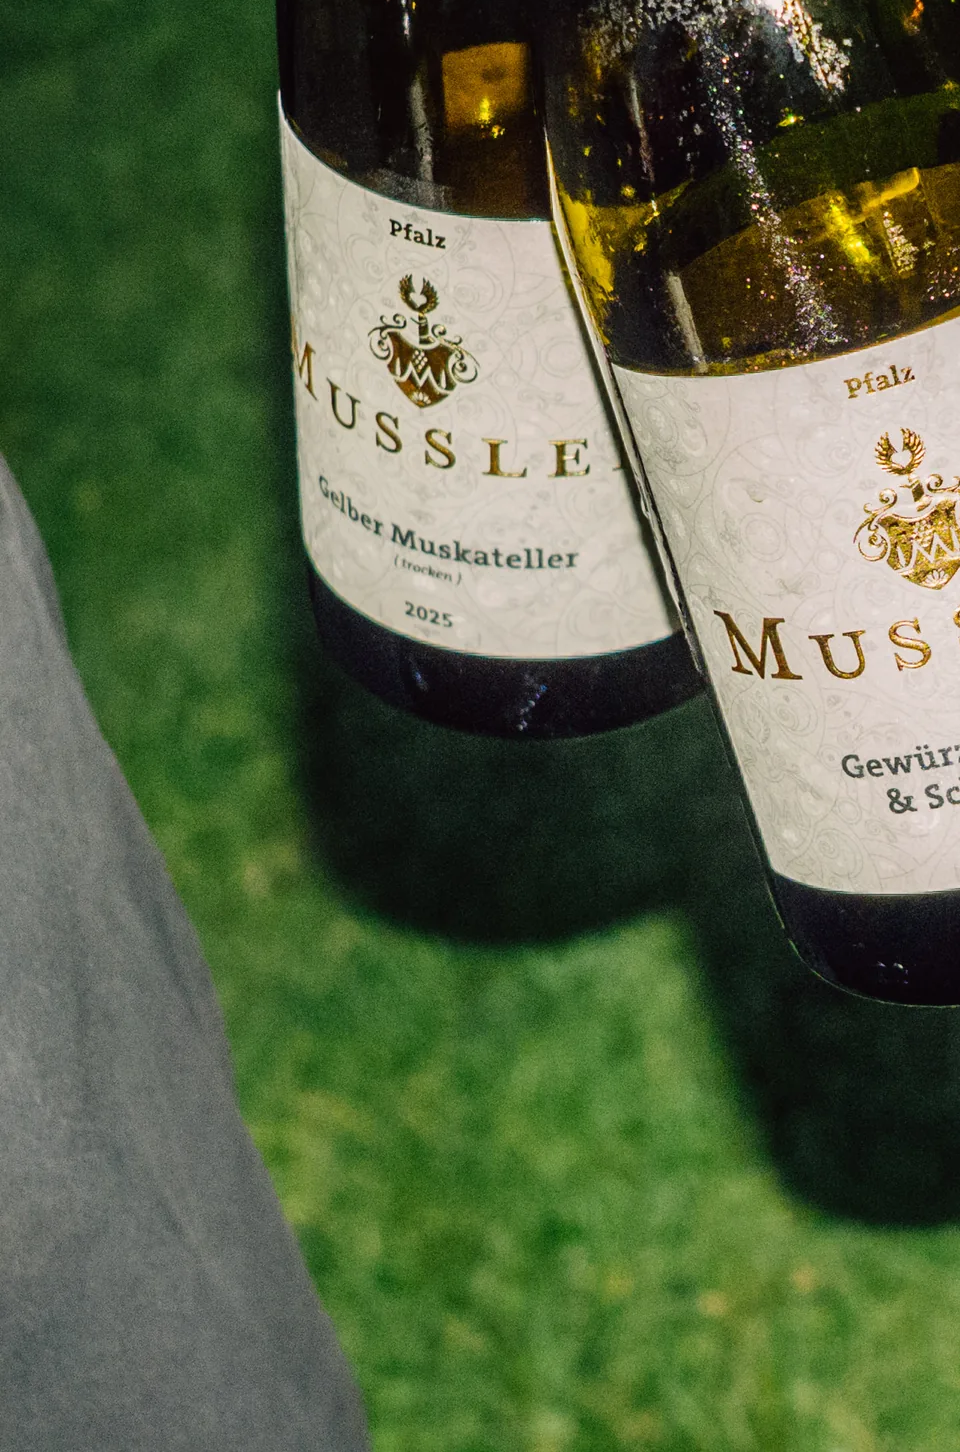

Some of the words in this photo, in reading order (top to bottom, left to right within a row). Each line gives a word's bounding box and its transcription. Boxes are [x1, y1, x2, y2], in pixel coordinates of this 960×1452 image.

[389, 218, 446, 250] Pfalz
[844, 364, 915, 399] Pfalz
[295, 341, 626, 479] MUSSLE
[319, 475, 384, 536] Gelber
[390, 522, 579, 579] Muskateller
[404, 600, 454, 629] 2025
[886, 787, 918, 815] &
